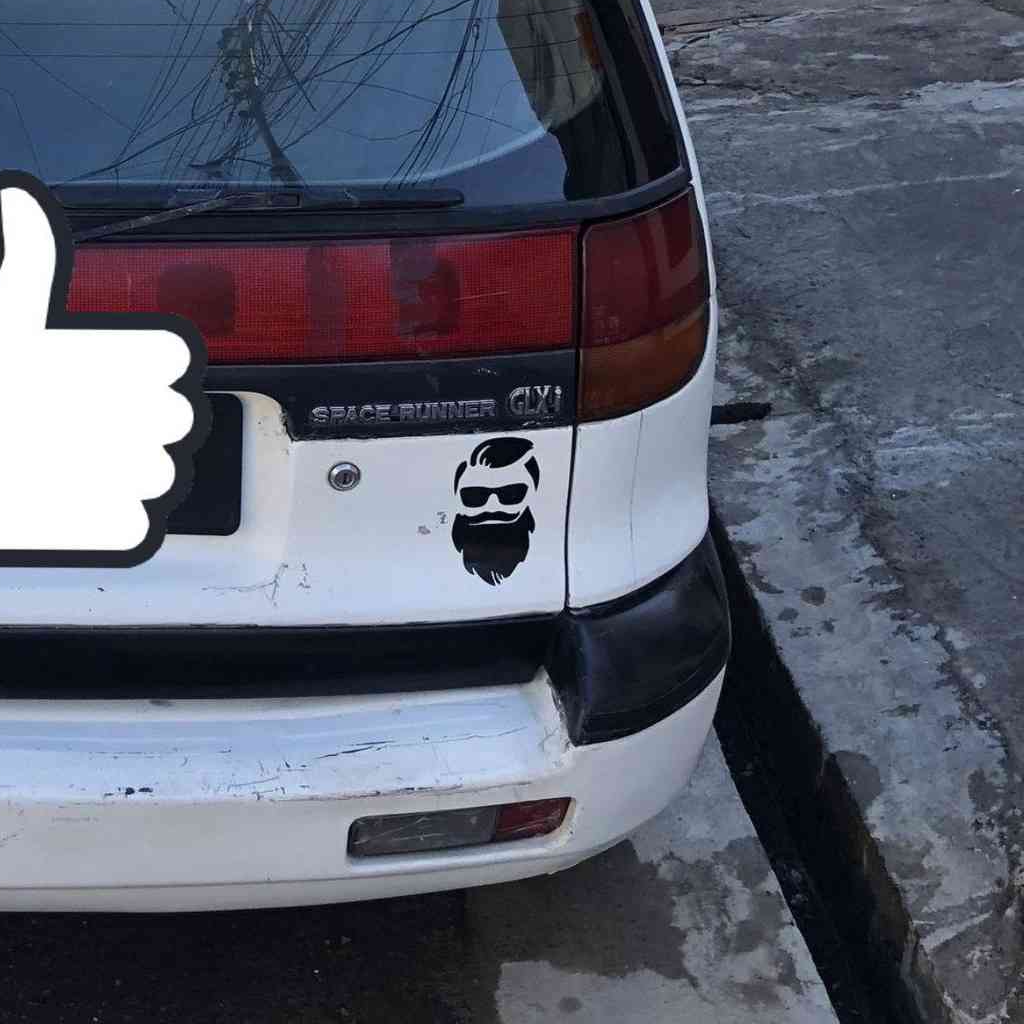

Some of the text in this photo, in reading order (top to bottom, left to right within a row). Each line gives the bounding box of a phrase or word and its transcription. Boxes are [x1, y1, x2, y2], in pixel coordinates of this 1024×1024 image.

[311, 385, 562, 424] SPACE RUNNER GLXi
